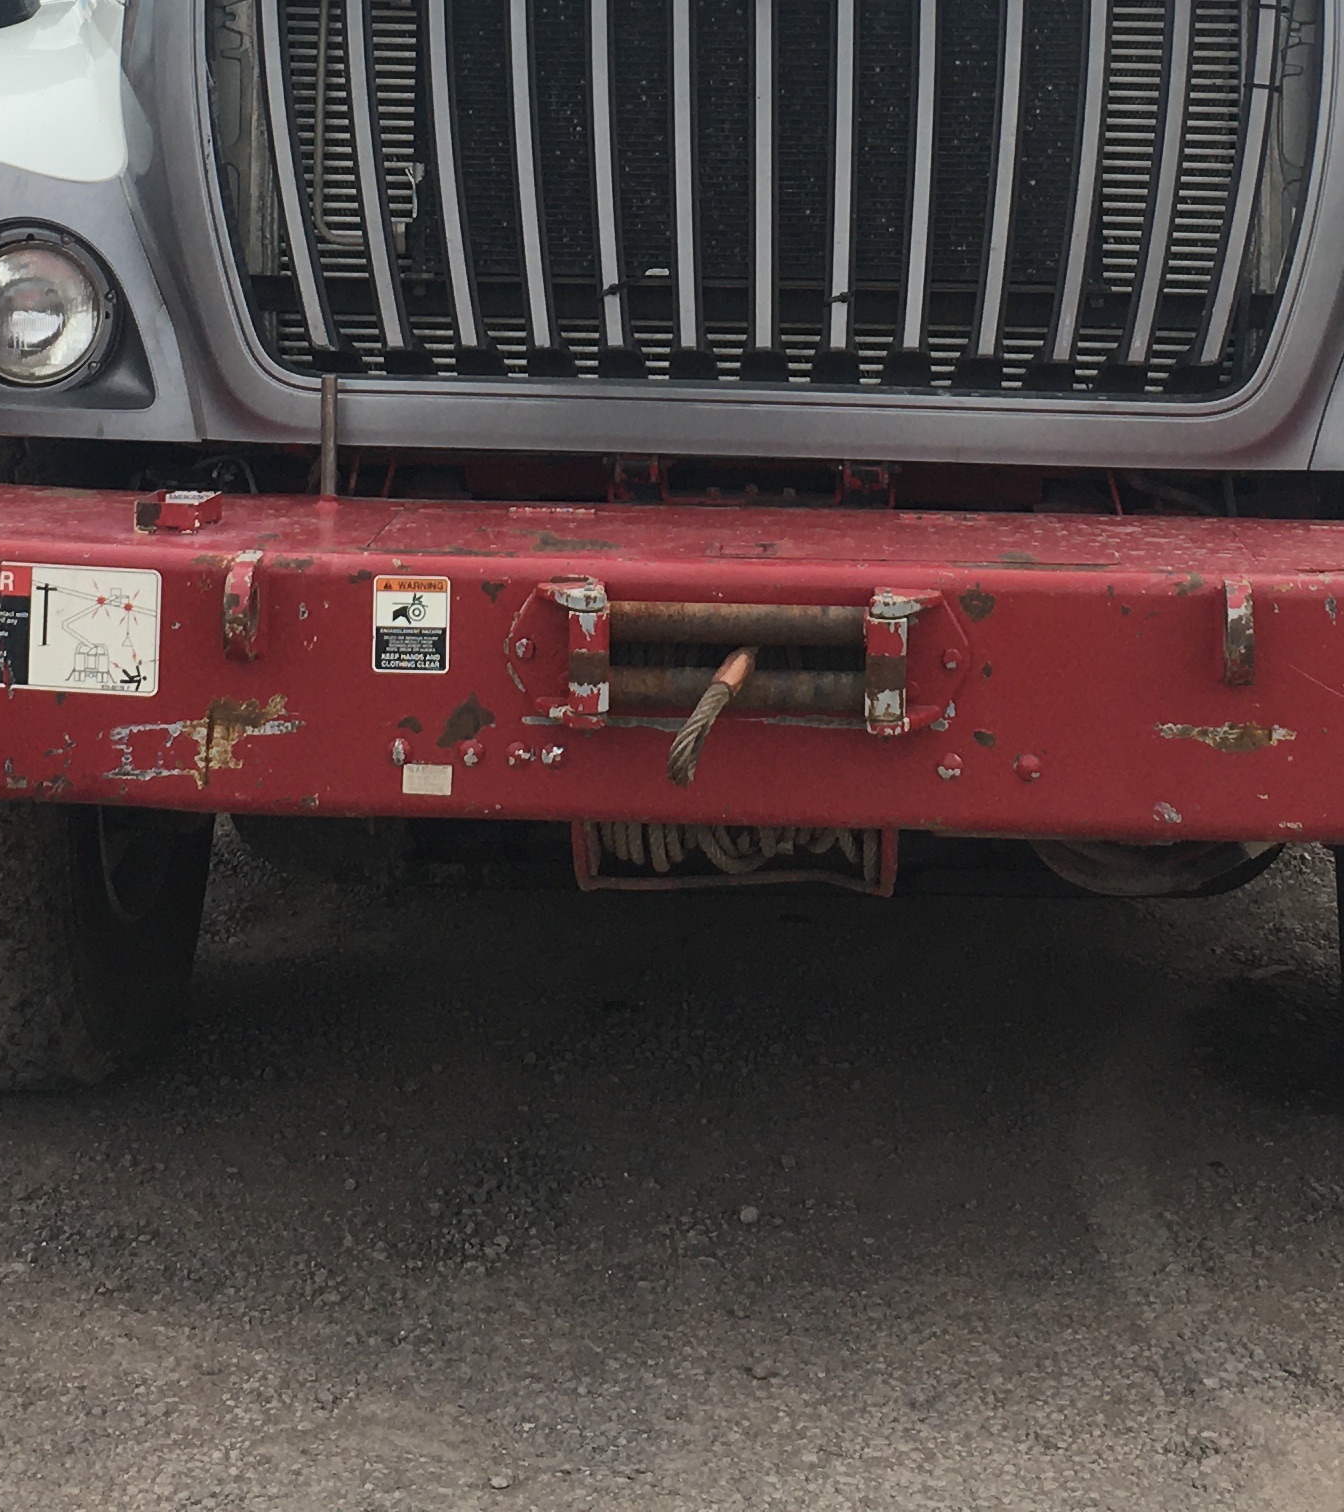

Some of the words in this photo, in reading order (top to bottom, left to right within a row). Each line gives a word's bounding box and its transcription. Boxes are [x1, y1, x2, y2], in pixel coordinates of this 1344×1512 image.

[398, 581, 444, 591] WARNING
[381, 652, 399, 660] KEEP
[400, 653, 424, 661] HANDS
[425, 653, 441, 661] AND
[381, 660, 415, 668] CLOTHING
[416, 660, 440, 668] CLEAR
